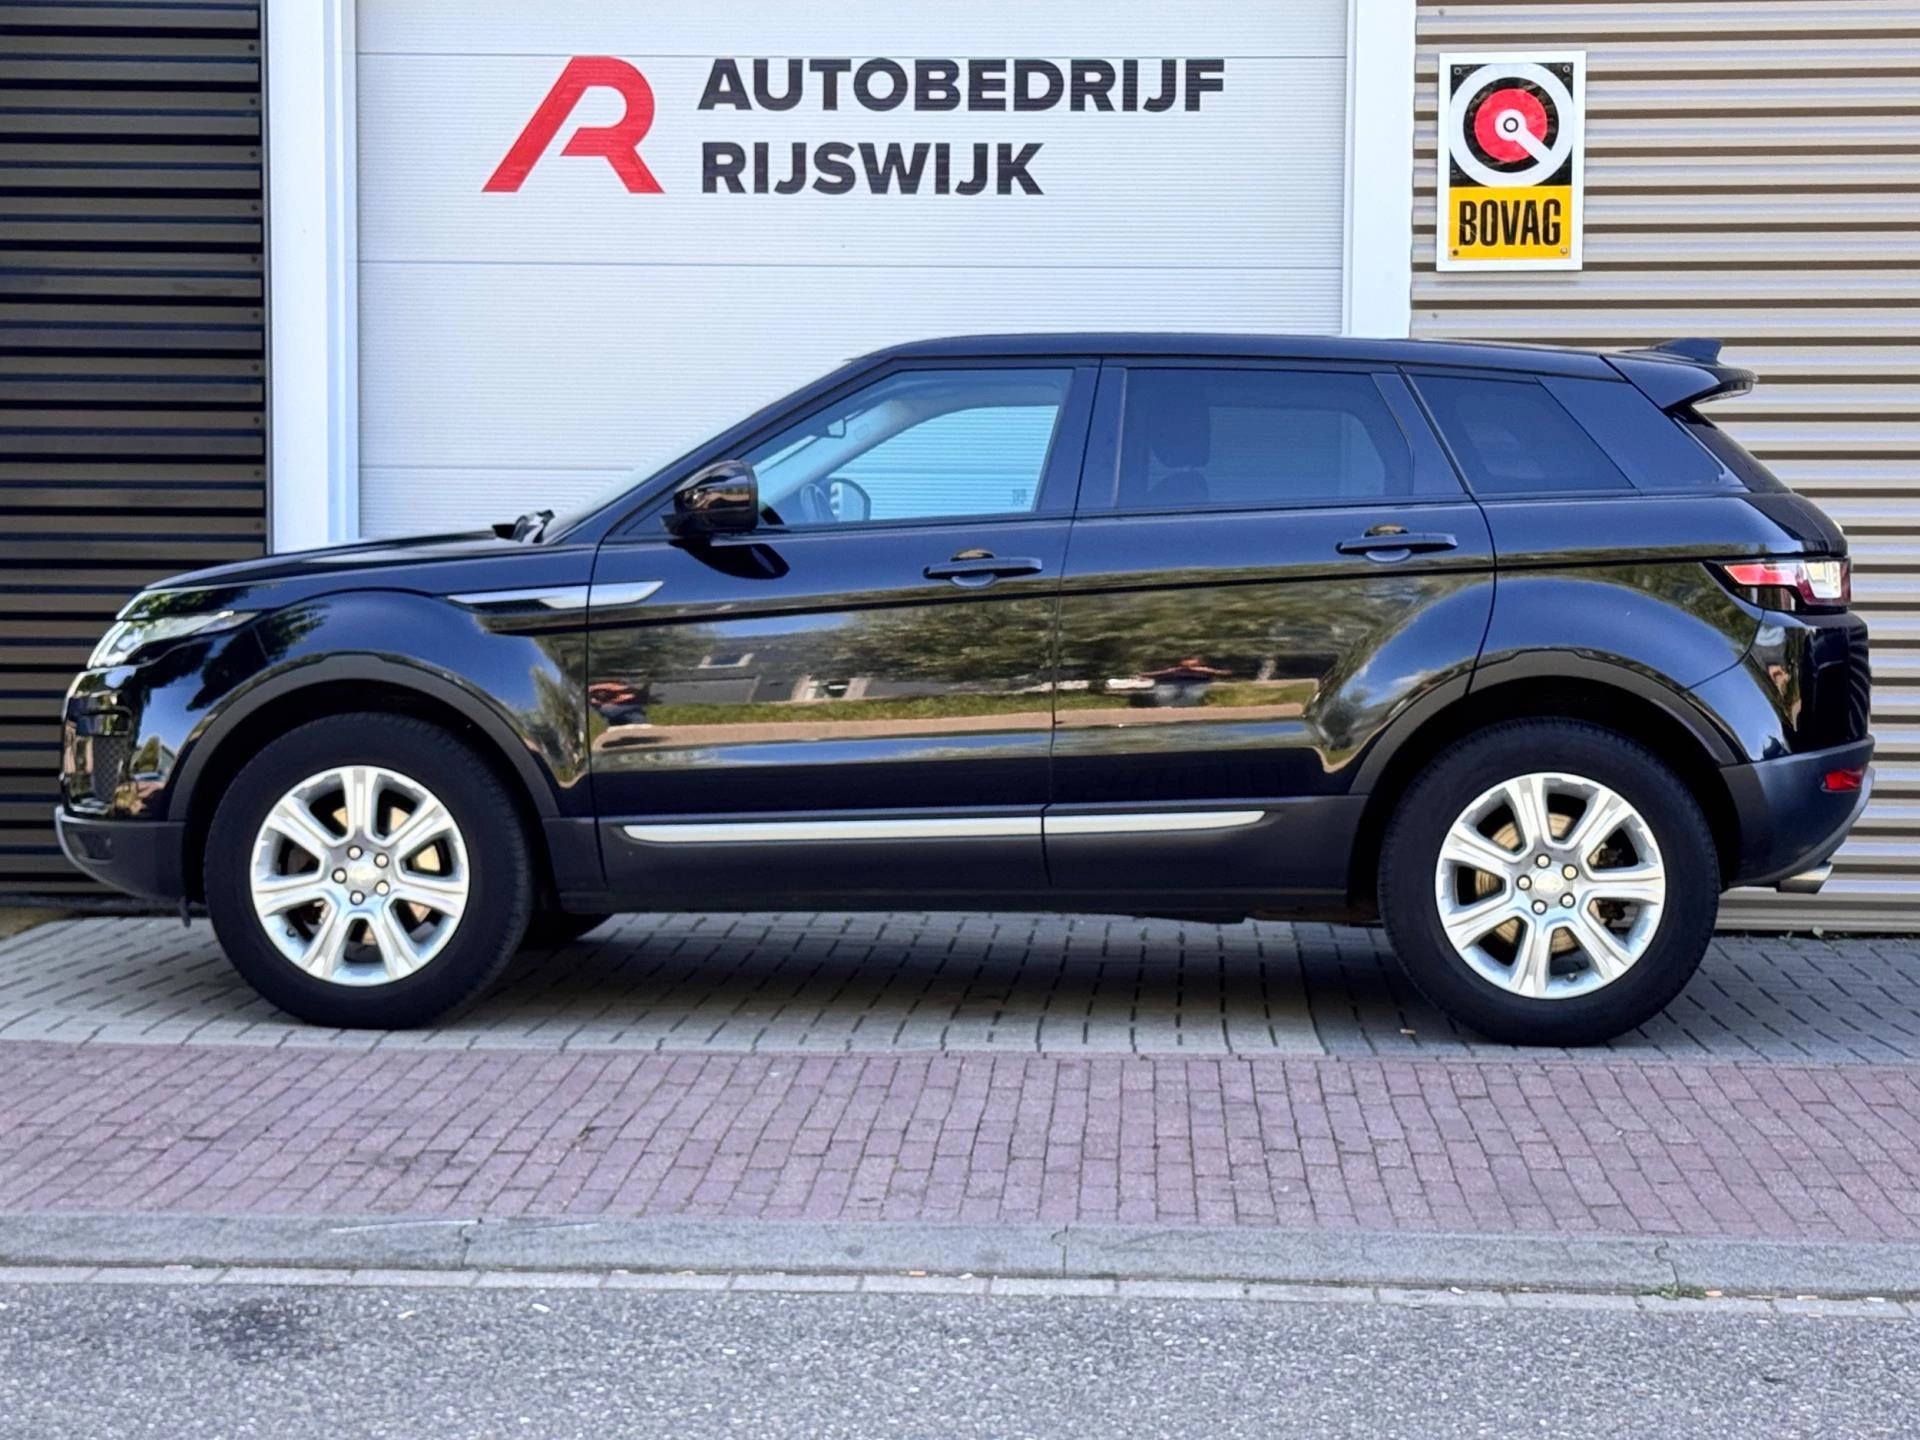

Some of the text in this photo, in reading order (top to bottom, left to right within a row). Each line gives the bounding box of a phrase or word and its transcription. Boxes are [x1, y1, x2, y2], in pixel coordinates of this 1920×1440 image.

[697, 58, 1226, 113] AUTOBEDRIJF
[702, 141, 1044, 196] RIJSWIJK
[1459, 199, 1561, 246] BOVAG
